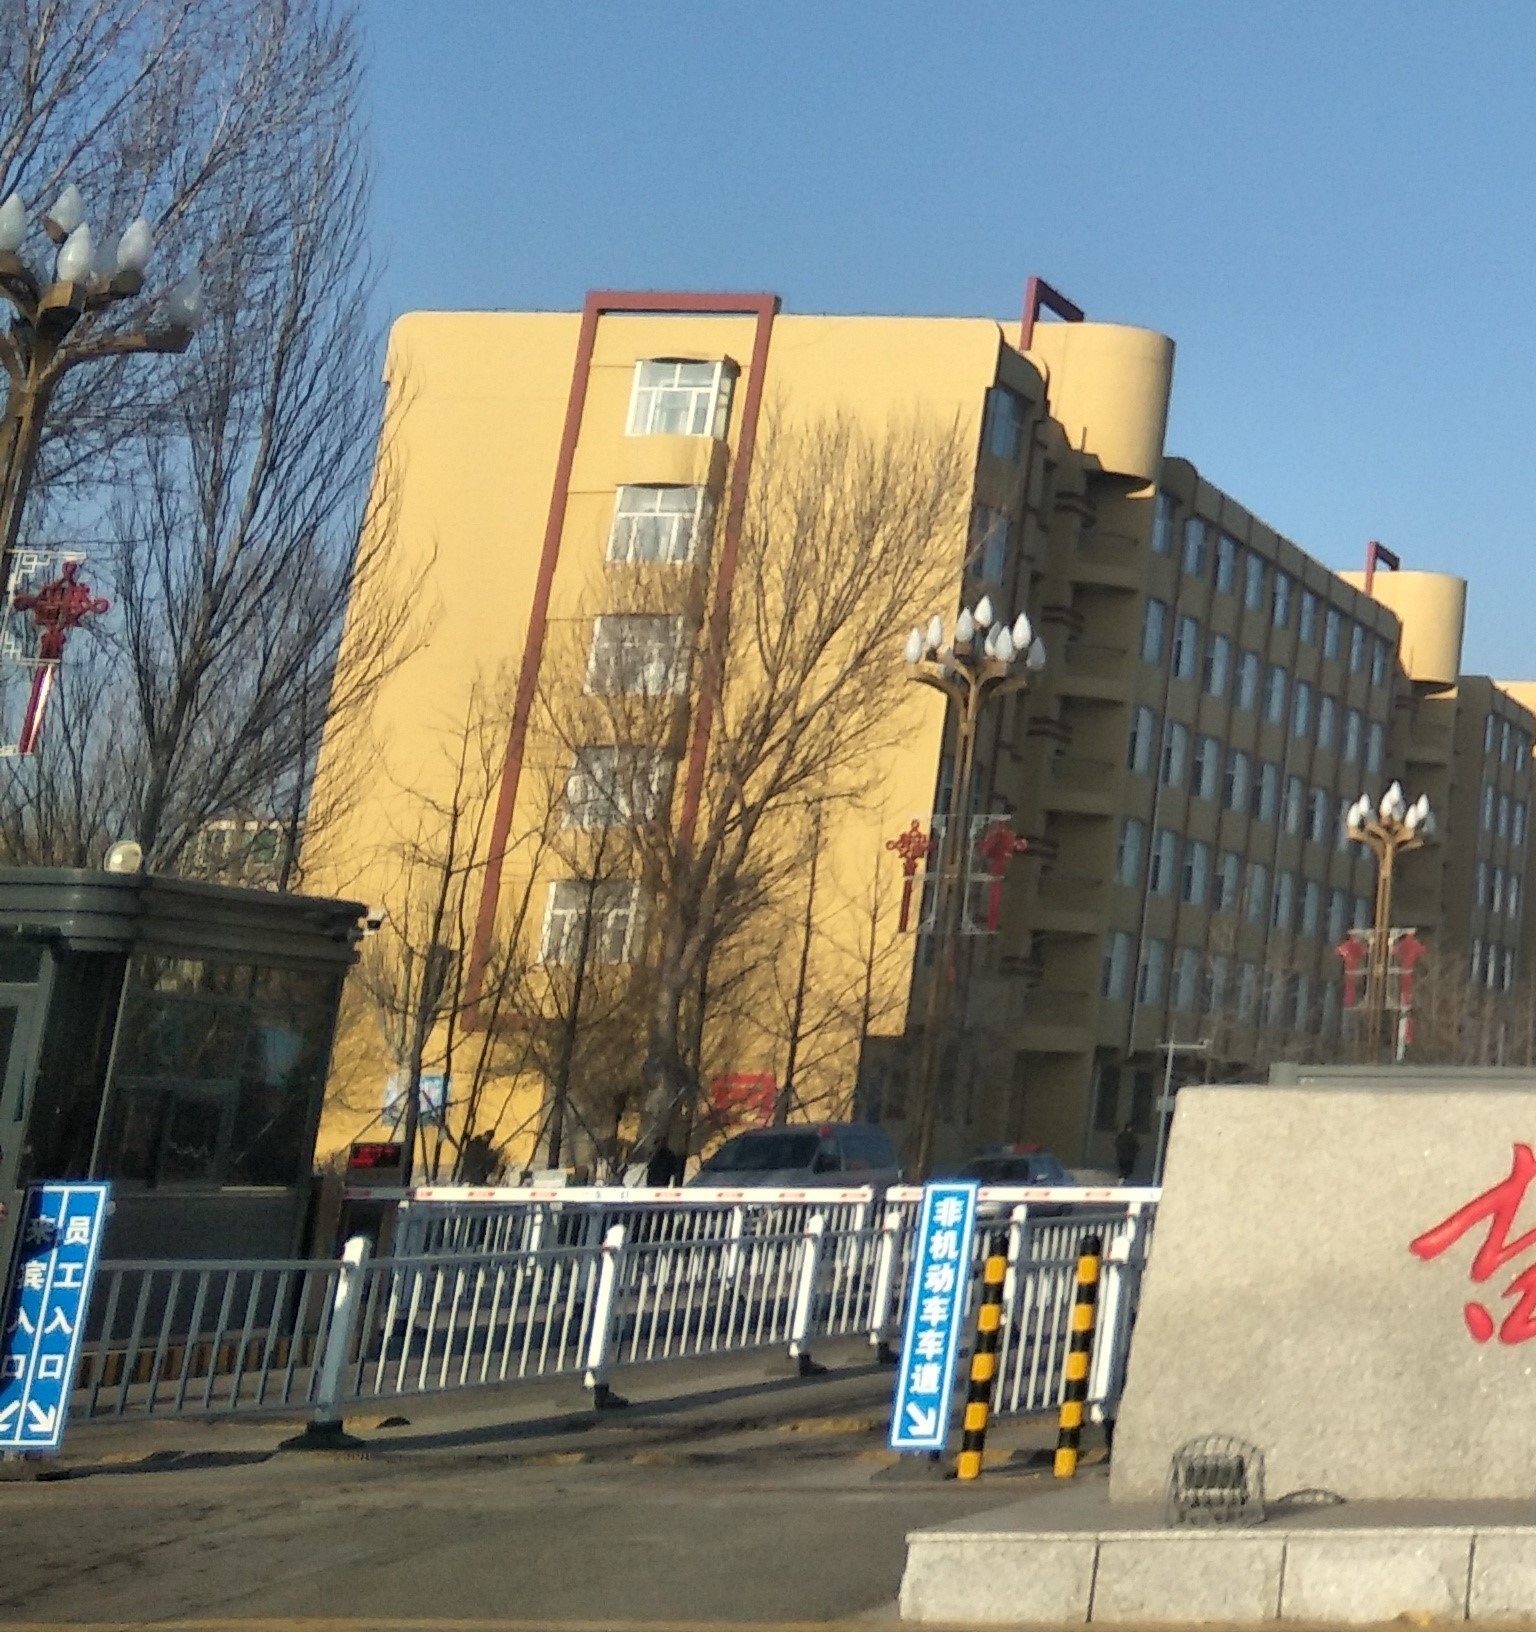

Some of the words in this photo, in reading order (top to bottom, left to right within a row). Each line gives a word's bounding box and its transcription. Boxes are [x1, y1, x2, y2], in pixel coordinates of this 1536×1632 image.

[2, 1215, 55, 1380] 来宾入口
[37, 1216, 91, 1380] 员工入口
[909, 1196, 964, 1395] 非机动车车道
